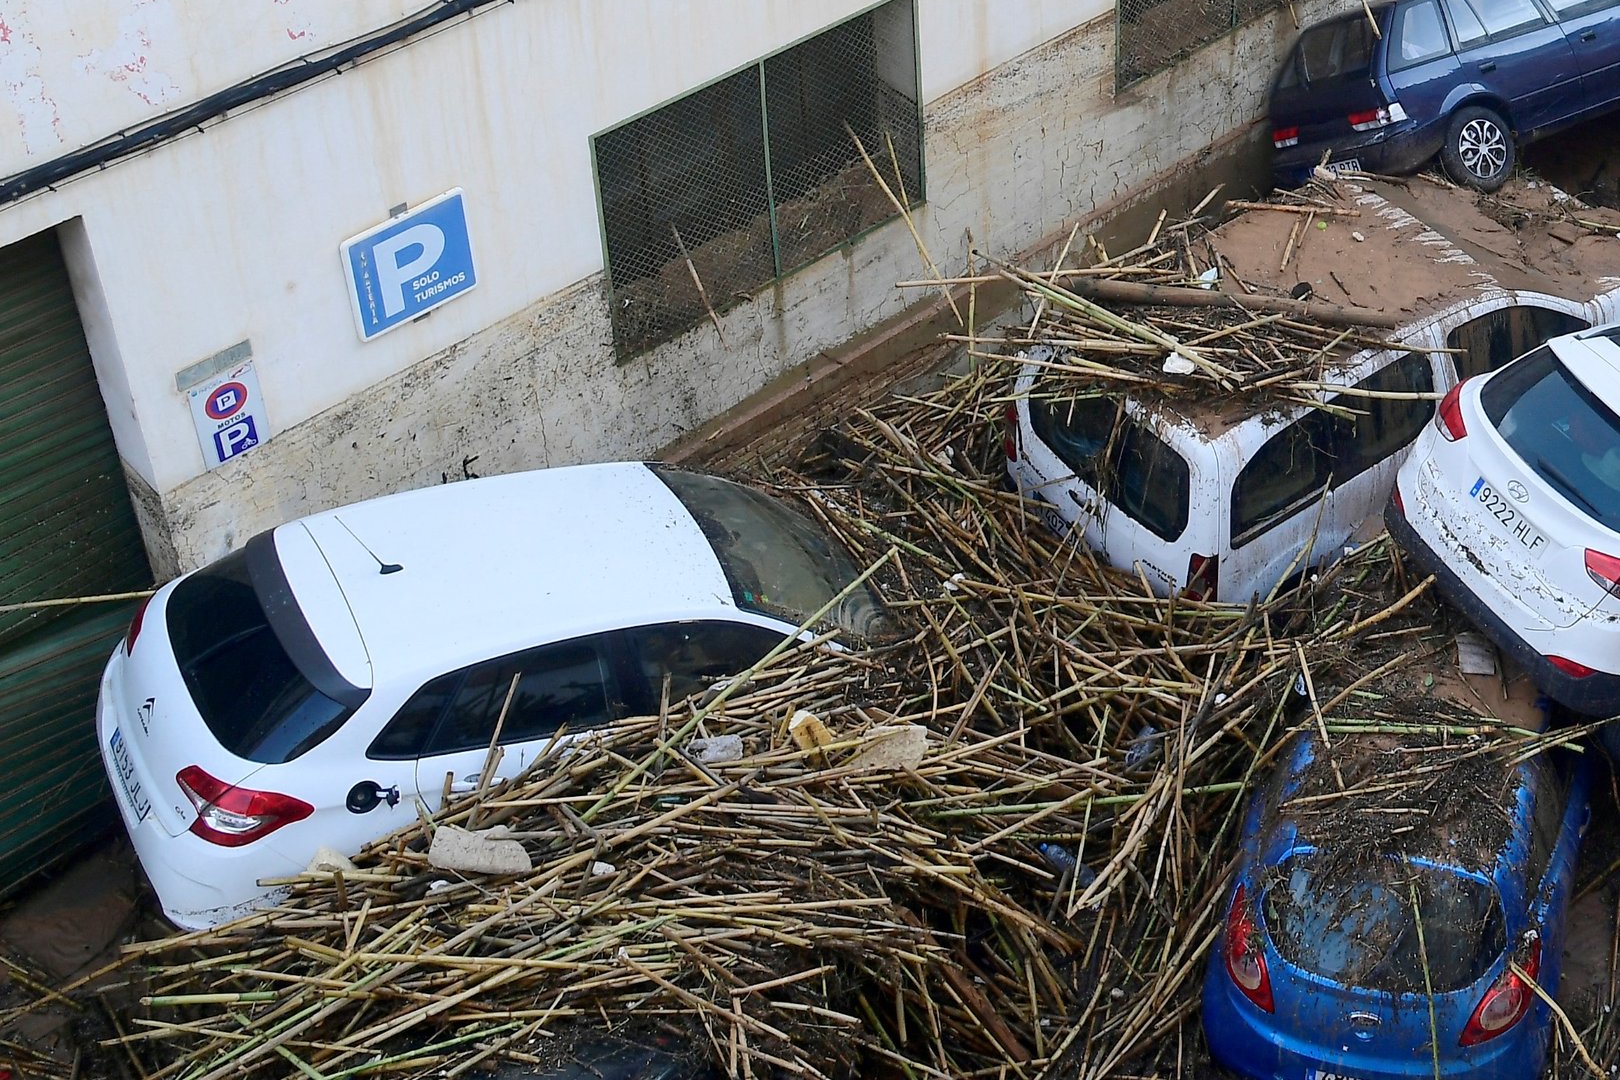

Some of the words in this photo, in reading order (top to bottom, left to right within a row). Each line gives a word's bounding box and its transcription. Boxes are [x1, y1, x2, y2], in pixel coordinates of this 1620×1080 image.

[412, 271, 440, 290] SOLO
[414, 271, 466, 303] TURISMOS
[217, 412, 246, 430] MOTOS
[1479, 487, 1515, 527] 9222
[1512, 520, 1544, 549] HLF
